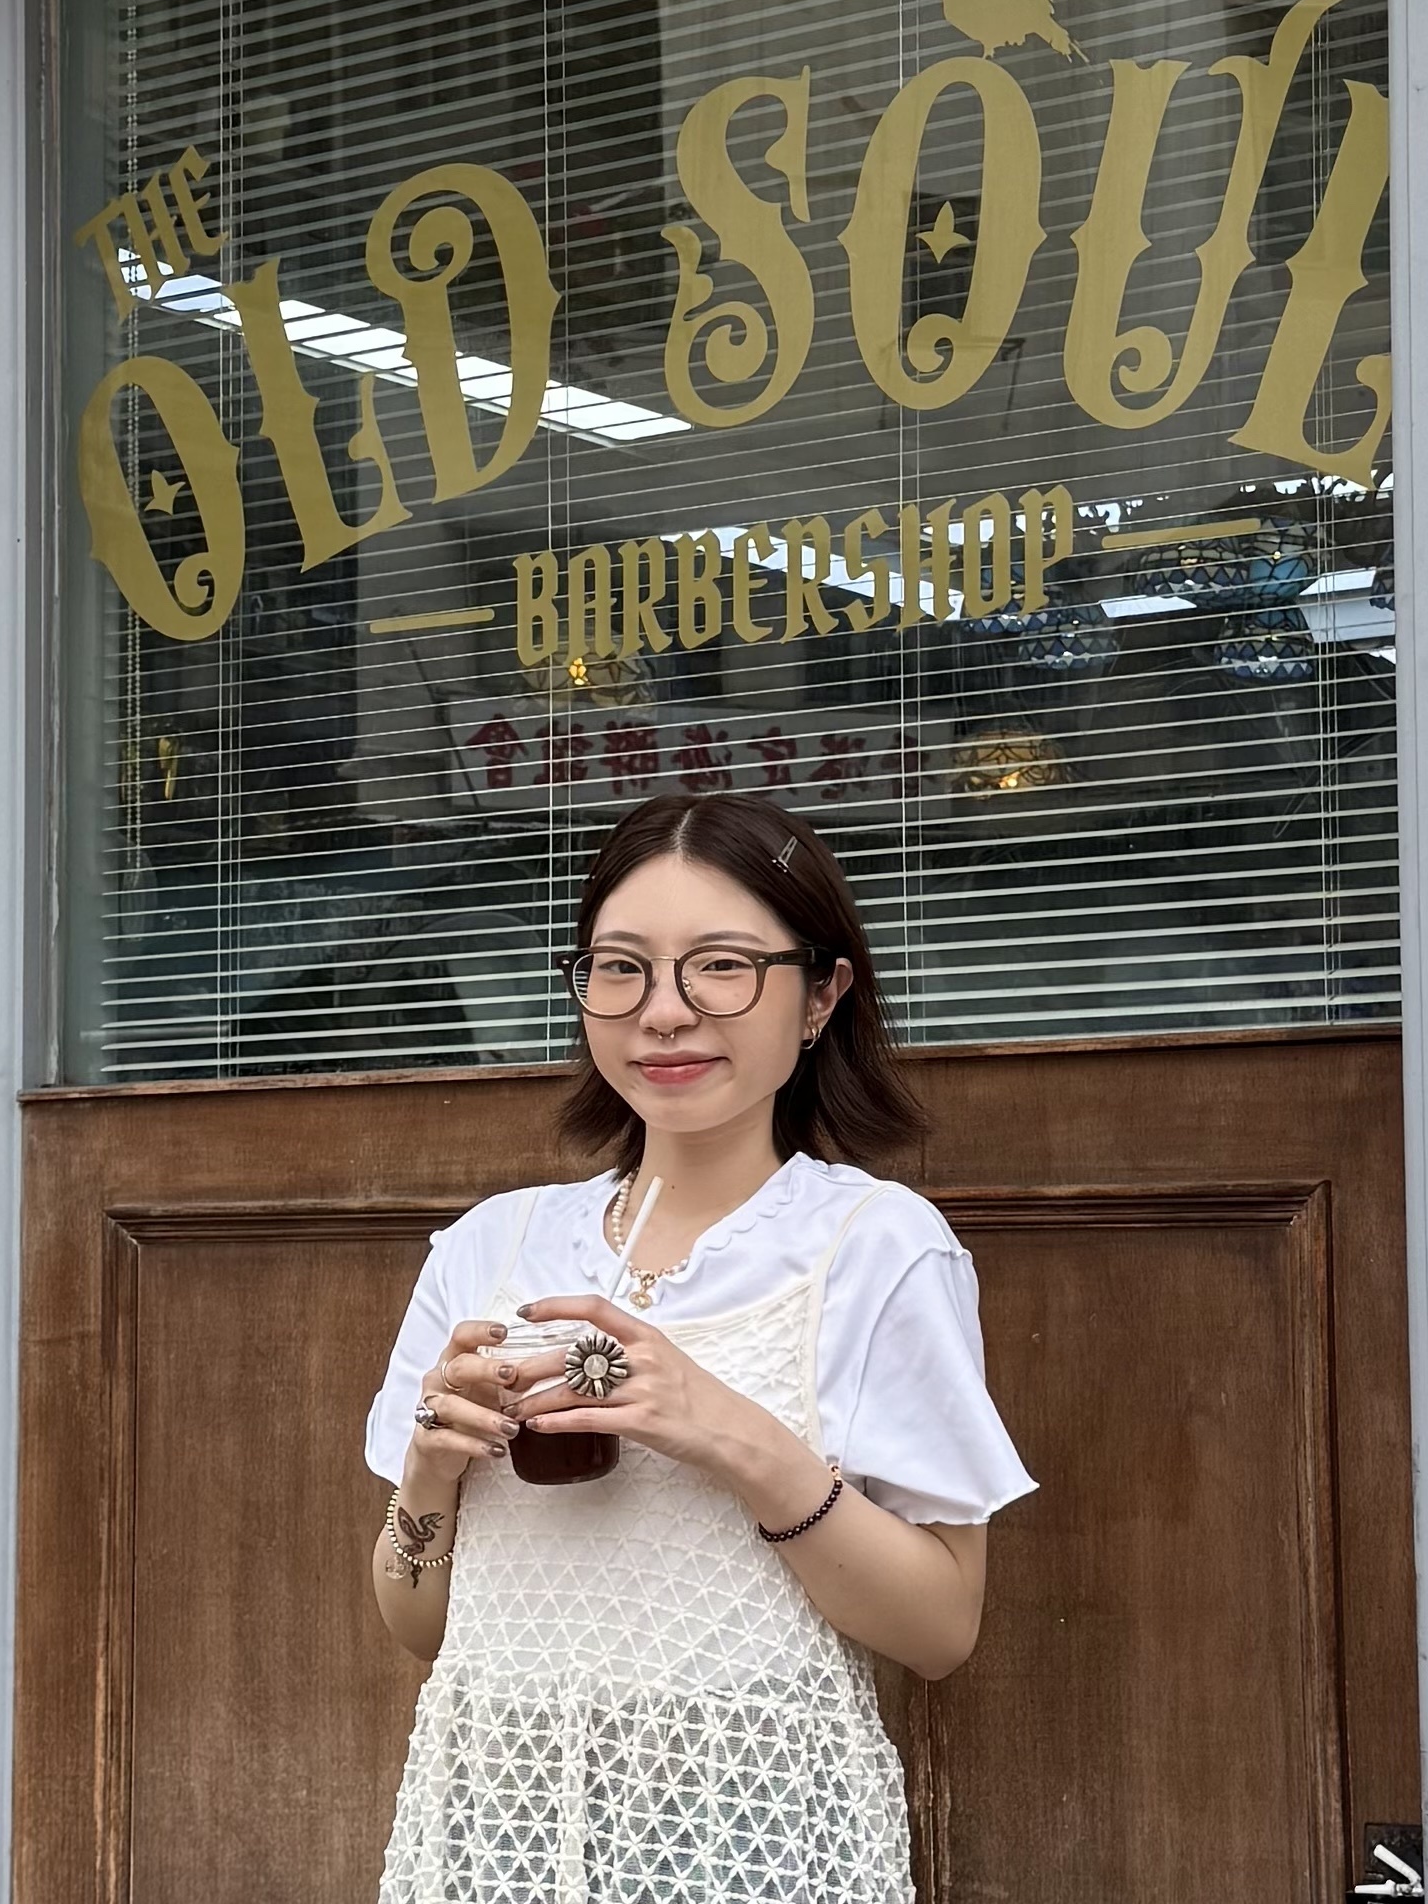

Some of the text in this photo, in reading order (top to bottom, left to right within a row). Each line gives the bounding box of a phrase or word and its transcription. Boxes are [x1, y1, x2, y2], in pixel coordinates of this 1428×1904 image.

[72, 143, 234, 324] THE
[76, 160, 562, 643] OLD
[513, 482, 1076, 671] BARBERSHOP
